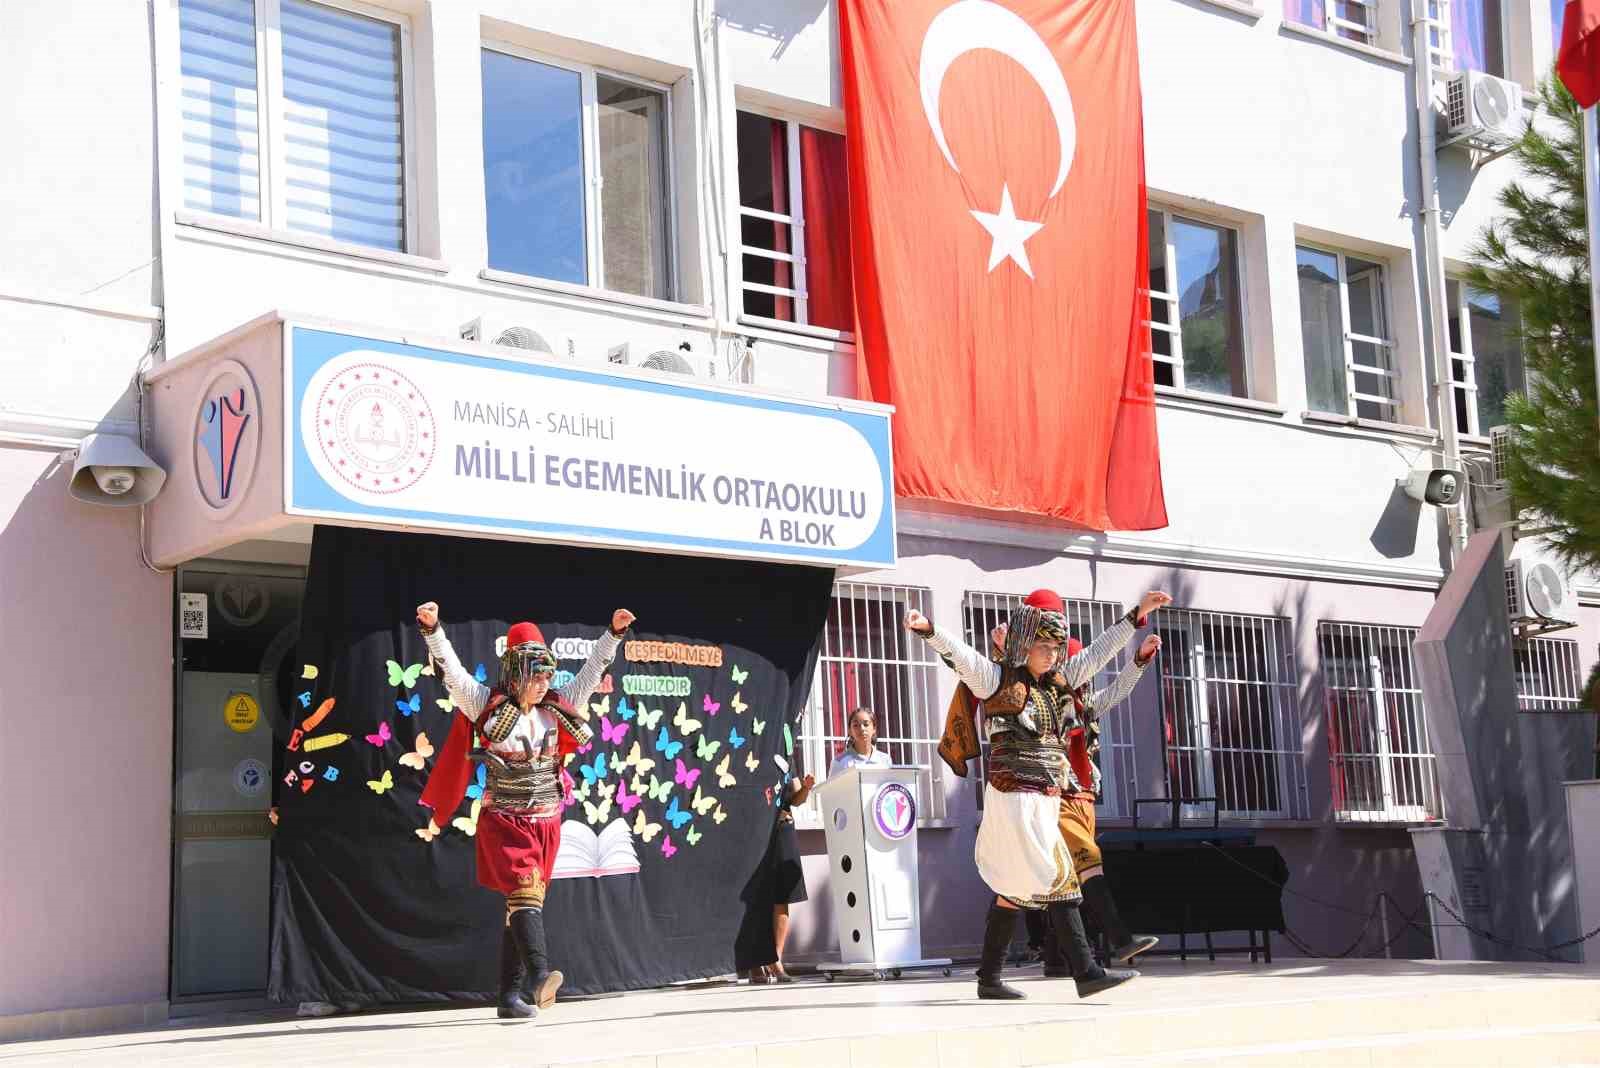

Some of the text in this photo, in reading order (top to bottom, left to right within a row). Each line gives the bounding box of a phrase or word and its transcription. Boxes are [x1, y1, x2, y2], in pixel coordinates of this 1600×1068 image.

[454, 400, 530, 430] MANİSA
[547, 412, 614, 440] SALİHLİ
[455, 440, 866, 519] MİLLİ EGEMENLİK ORTAOKULU
[759, 517, 836, 546] A BLOK
[555, 641, 597, 658] ÇOCU
